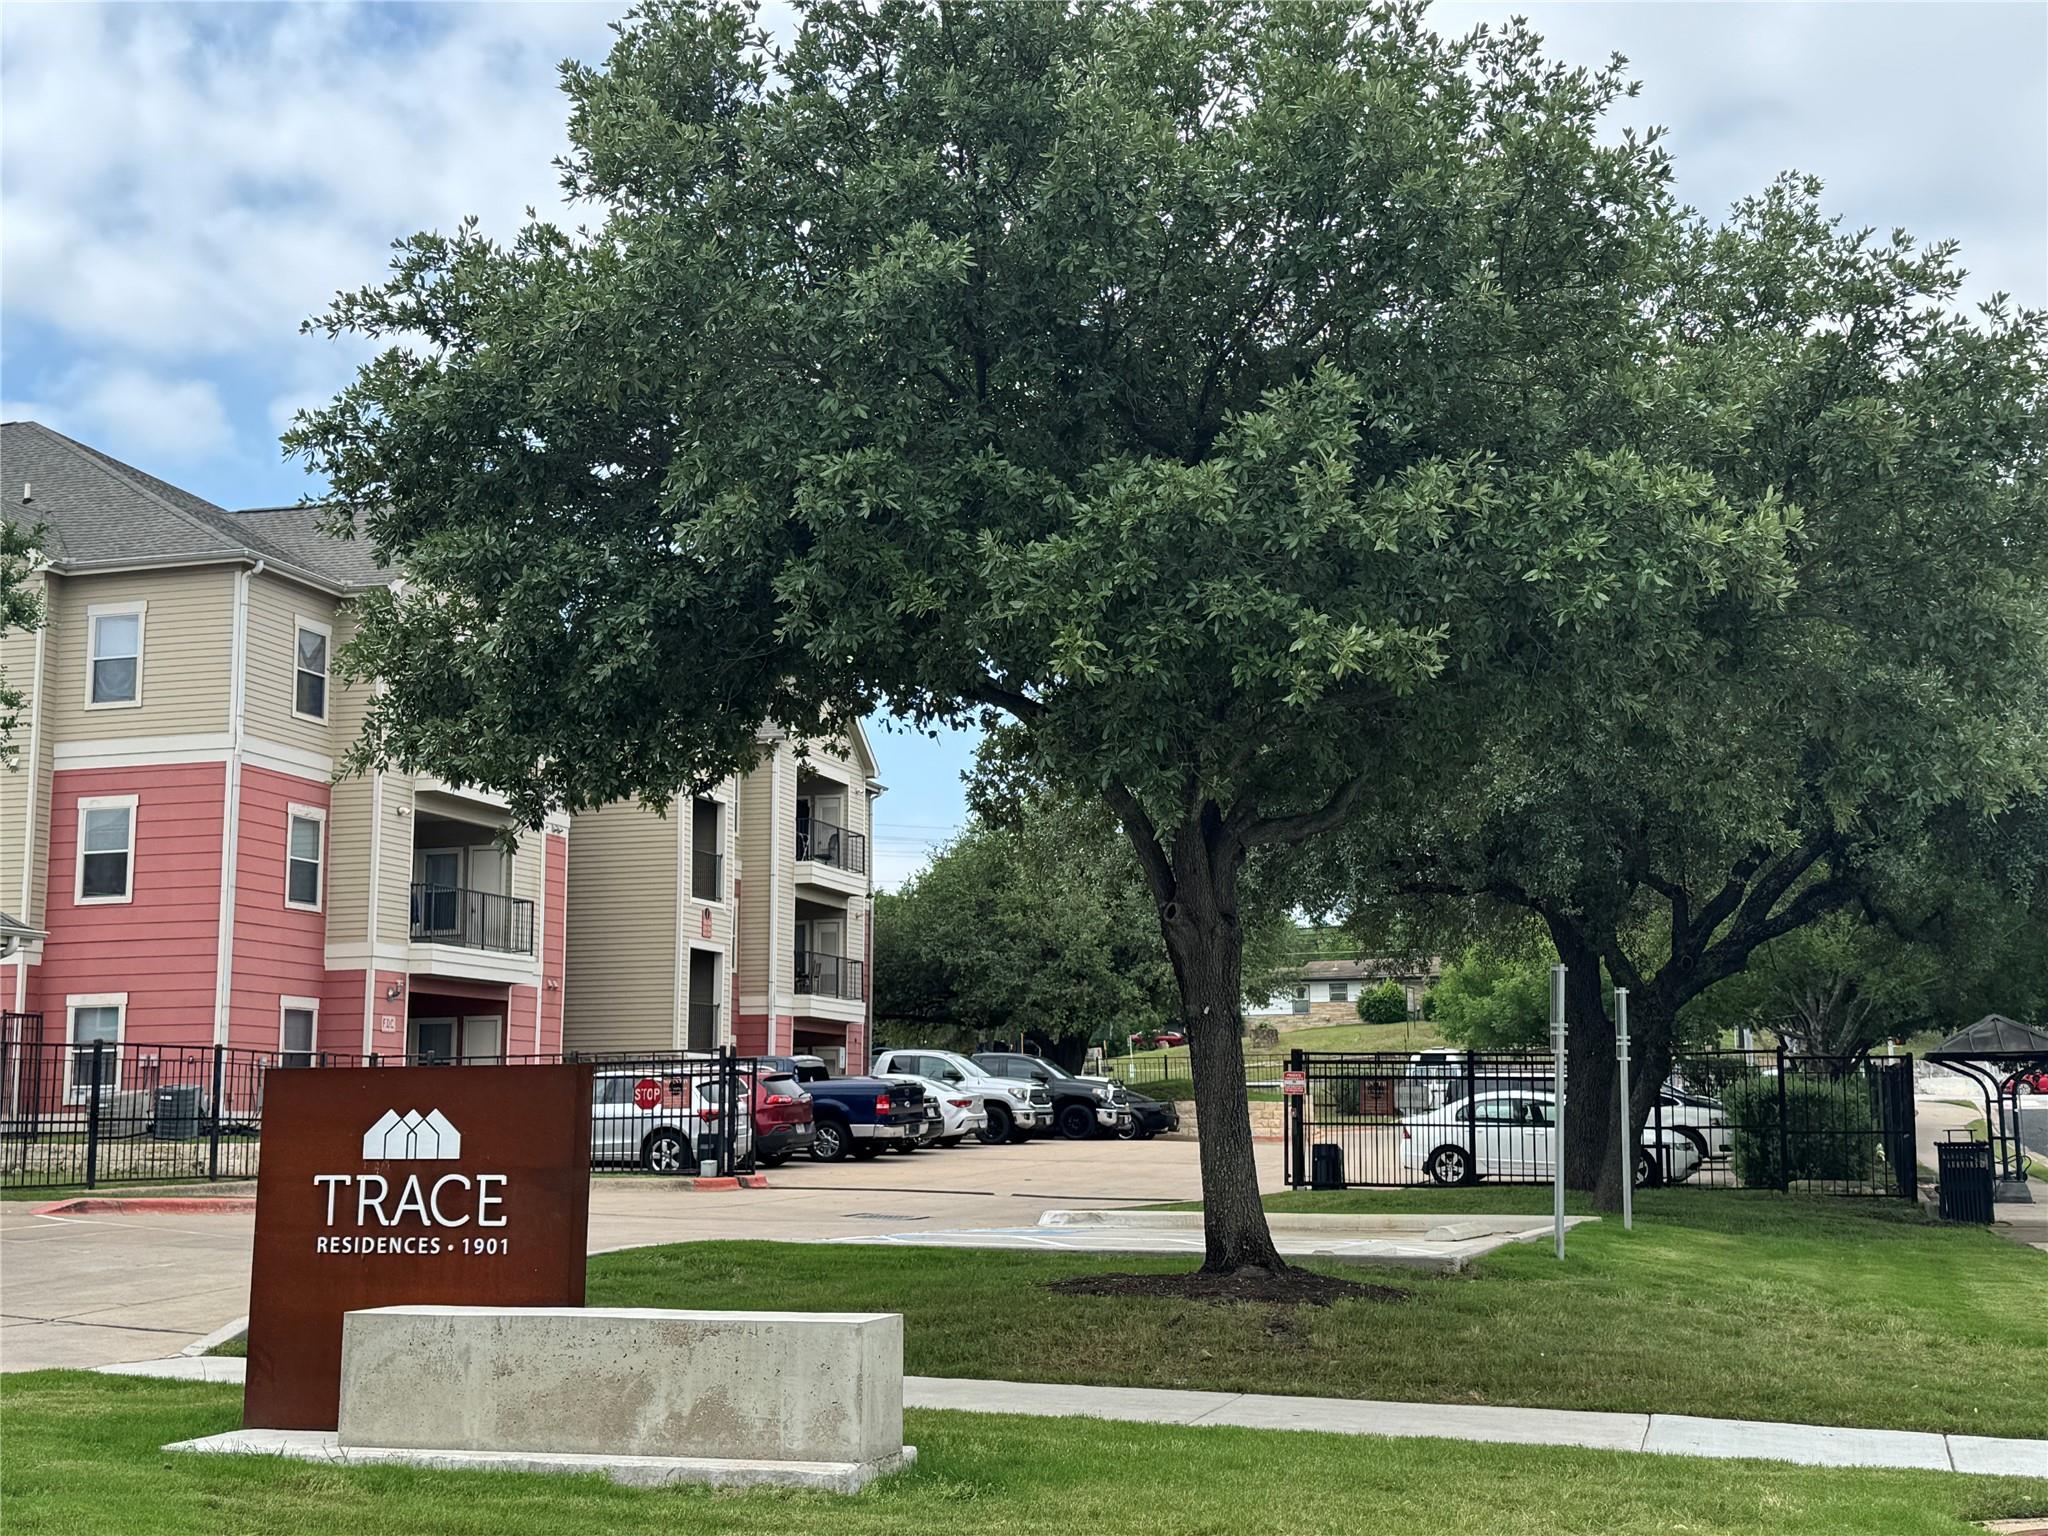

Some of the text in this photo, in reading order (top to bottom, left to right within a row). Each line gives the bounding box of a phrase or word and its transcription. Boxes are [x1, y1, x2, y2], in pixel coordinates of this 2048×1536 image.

[634, 1088, 661, 1101] STOP
[313, 1173, 508, 1228] TRACE
[316, 1236, 509, 1255] RESIDENCES 1901
